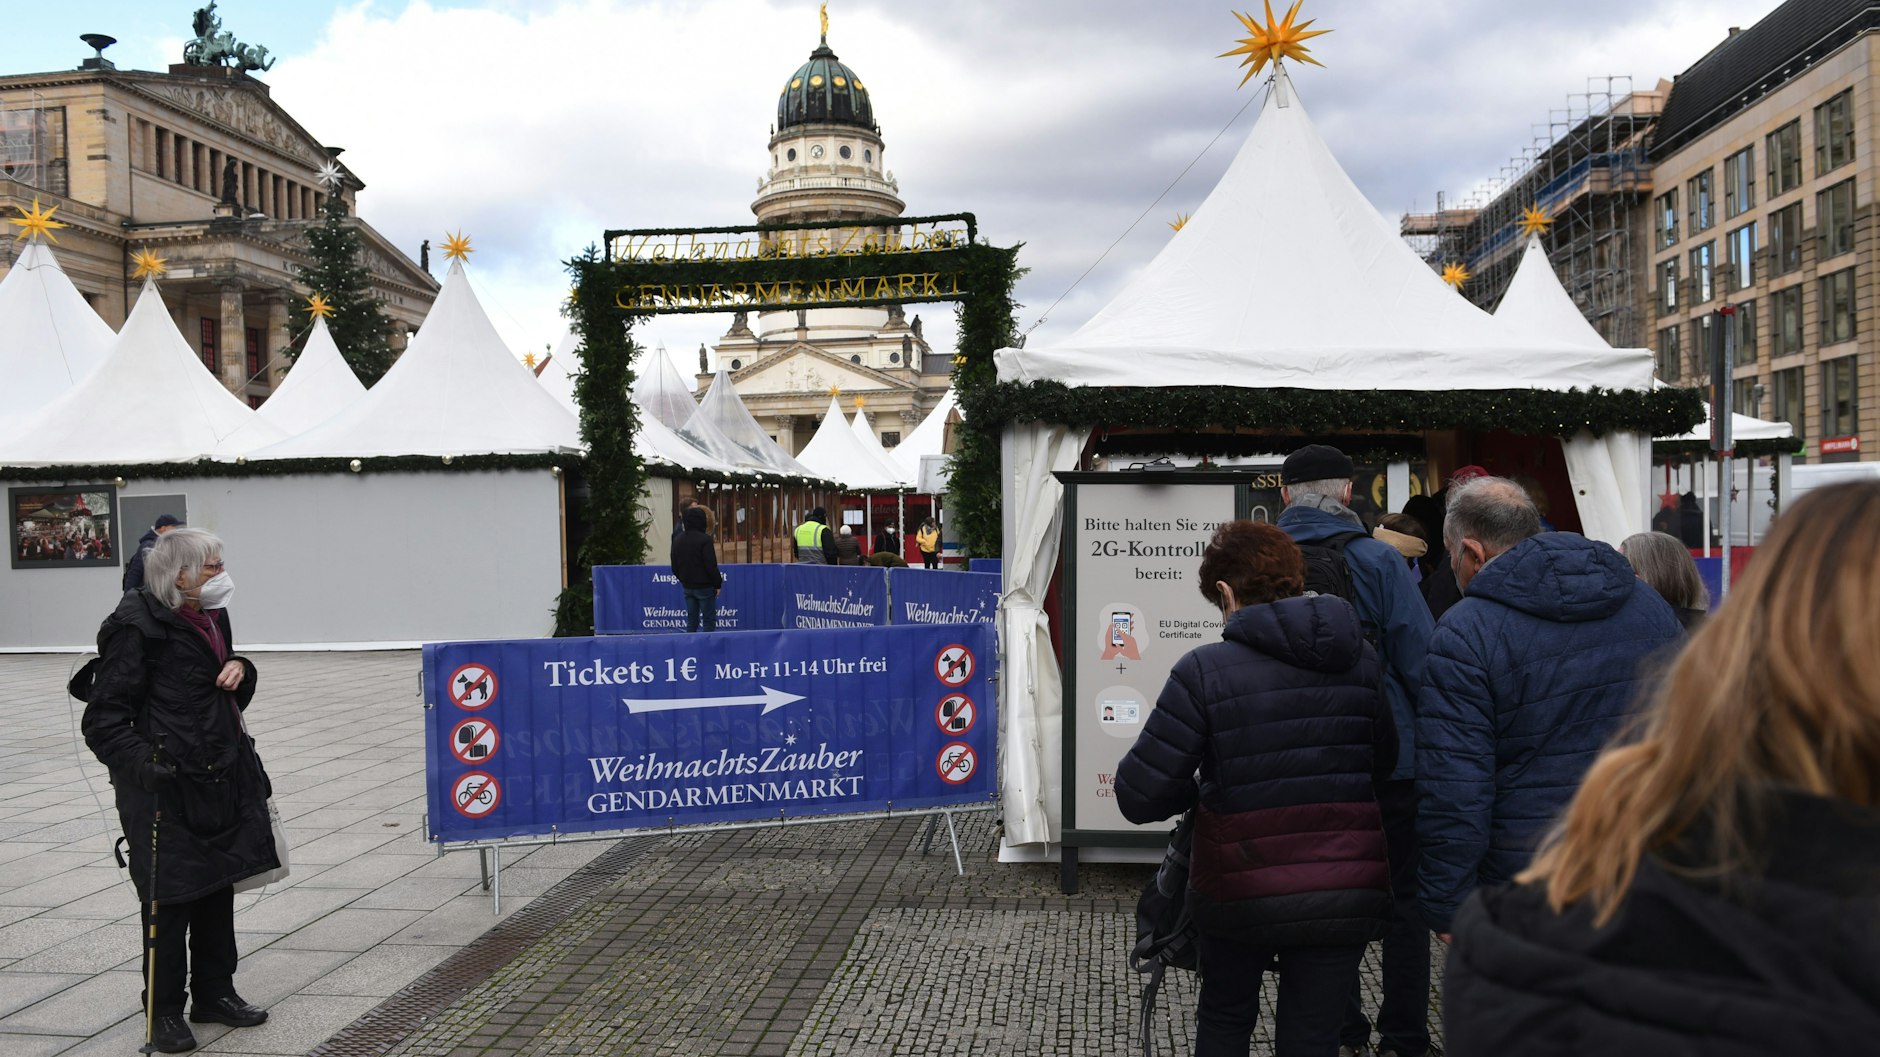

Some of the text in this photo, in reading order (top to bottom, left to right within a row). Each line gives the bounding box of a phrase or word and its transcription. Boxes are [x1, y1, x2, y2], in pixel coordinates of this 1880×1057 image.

[614, 271, 964, 310] GENDARMENMARKT
[1084, 518, 1220, 531] Bitte halten Sie zu
[1091, 540, 1206, 558] 2G-Kontroll
[1135, 567, 1182, 580] bereit:
[796, 593, 874, 617] WeihnachtsZauber
[1159, 620, 1172, 628] EU
[1174, 620, 1201, 630] Digital
[1159, 630, 1202, 639] Certificate
[543, 656, 888, 687] Tickets 1€ Mo-Fr 11-14 Uhr frei
[587, 744, 864, 784] WeihnachtsZauber
[587, 775, 864, 815] GENDARMENMARKT
